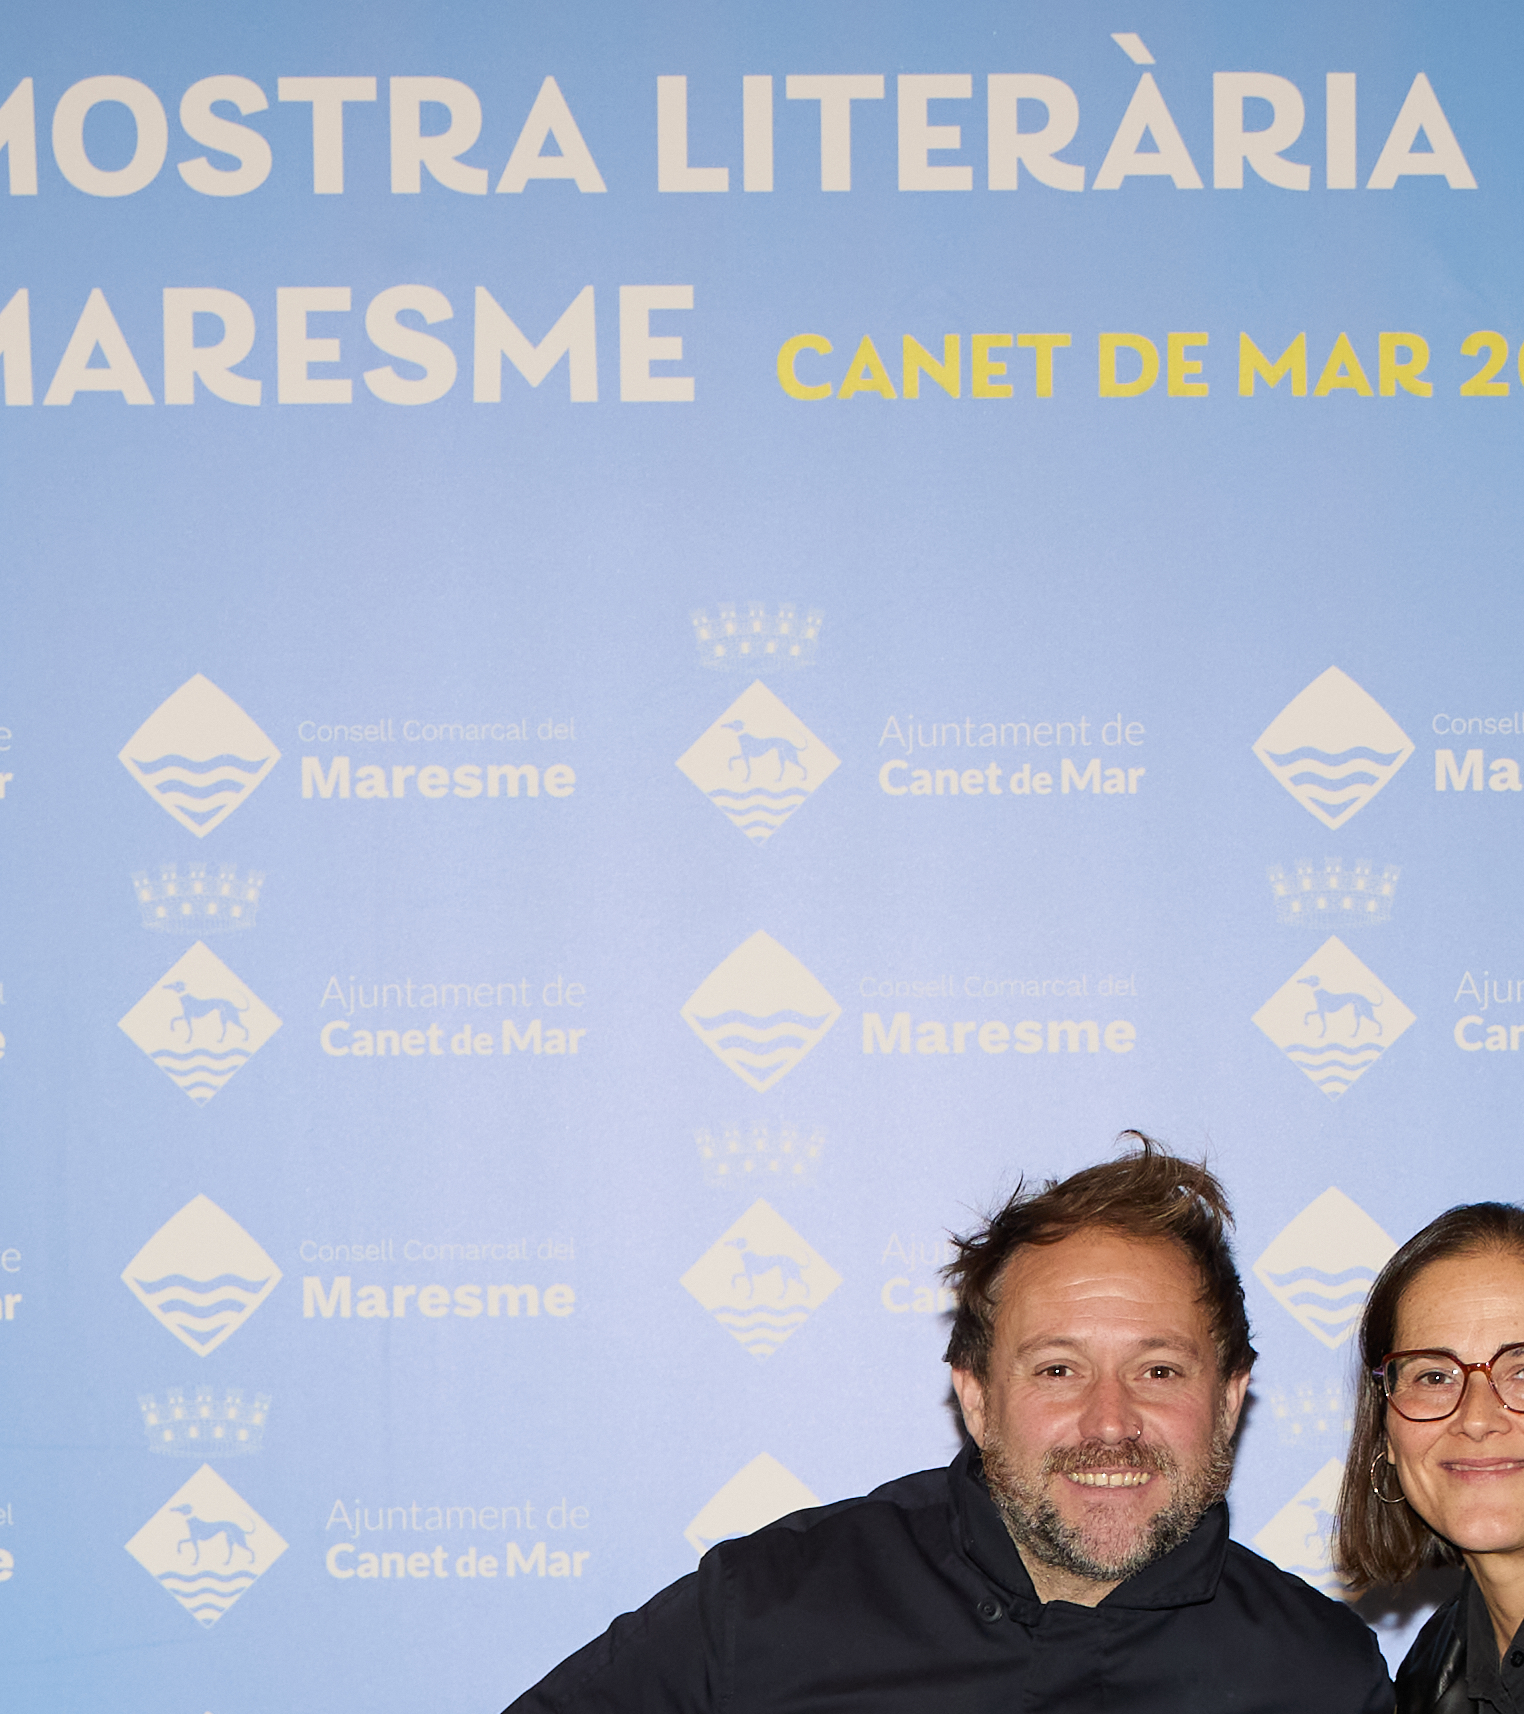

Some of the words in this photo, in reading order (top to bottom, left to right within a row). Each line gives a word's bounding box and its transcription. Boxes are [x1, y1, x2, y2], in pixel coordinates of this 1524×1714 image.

[657, 33, 1479, 193] LITERÀRIA
[776, 332, 1071, 401] CANET
[1098, 332, 1209, 399] DE
[1238, 330, 1433, 399] MAR
[298, 719, 393, 741] Consell
[403, 719, 527, 741] Comarcal
[537, 719, 574, 741] del
[880, 715, 1090, 754] Ajuntament
[1102, 713, 1145, 745] de
[301, 756, 576, 799] Maresme
[878, 759, 1003, 796] Canet
[1009, 763, 1053, 795] de
[1061, 758, 1146, 794] Mar
[862, 1012, 1137, 1055] Maresme
[303, 1276, 576, 1319] Maresme
